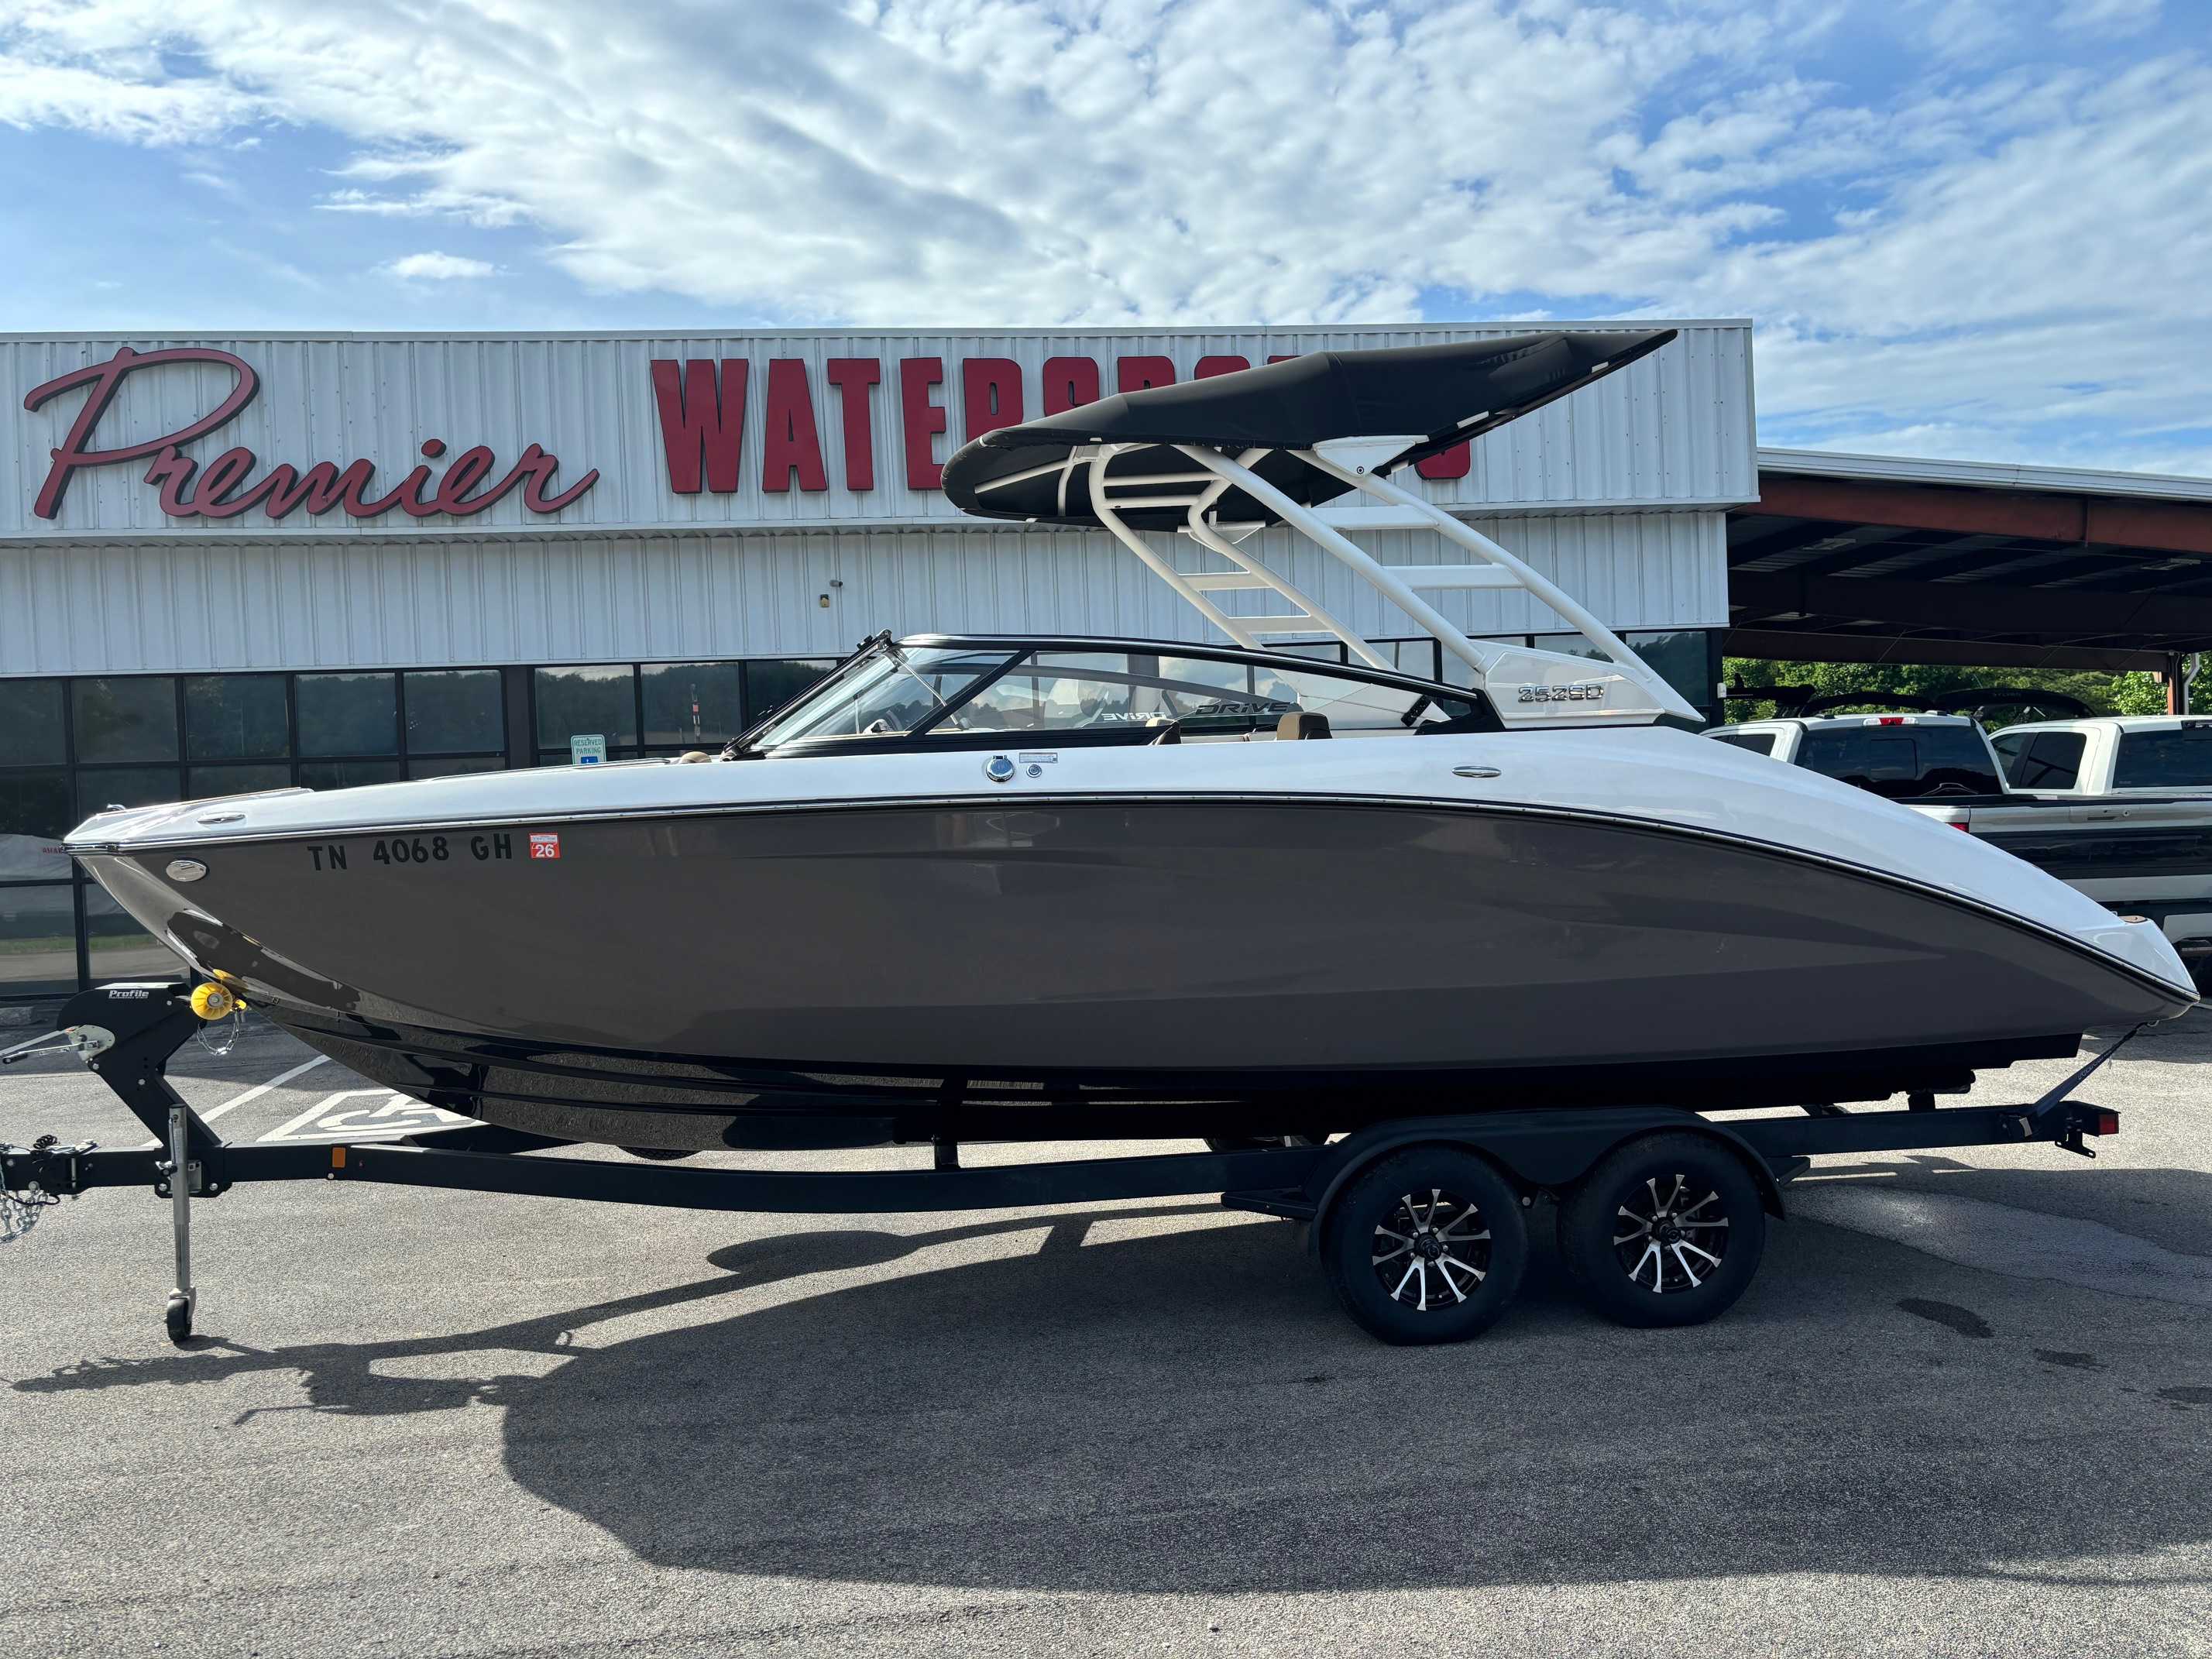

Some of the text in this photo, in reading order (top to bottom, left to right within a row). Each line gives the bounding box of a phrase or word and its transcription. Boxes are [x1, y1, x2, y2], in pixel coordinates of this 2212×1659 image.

[24, 346, 601, 520] Premier
[307, 833, 513, 871] TN 4068 GH
[536, 843, 556, 857] 26
